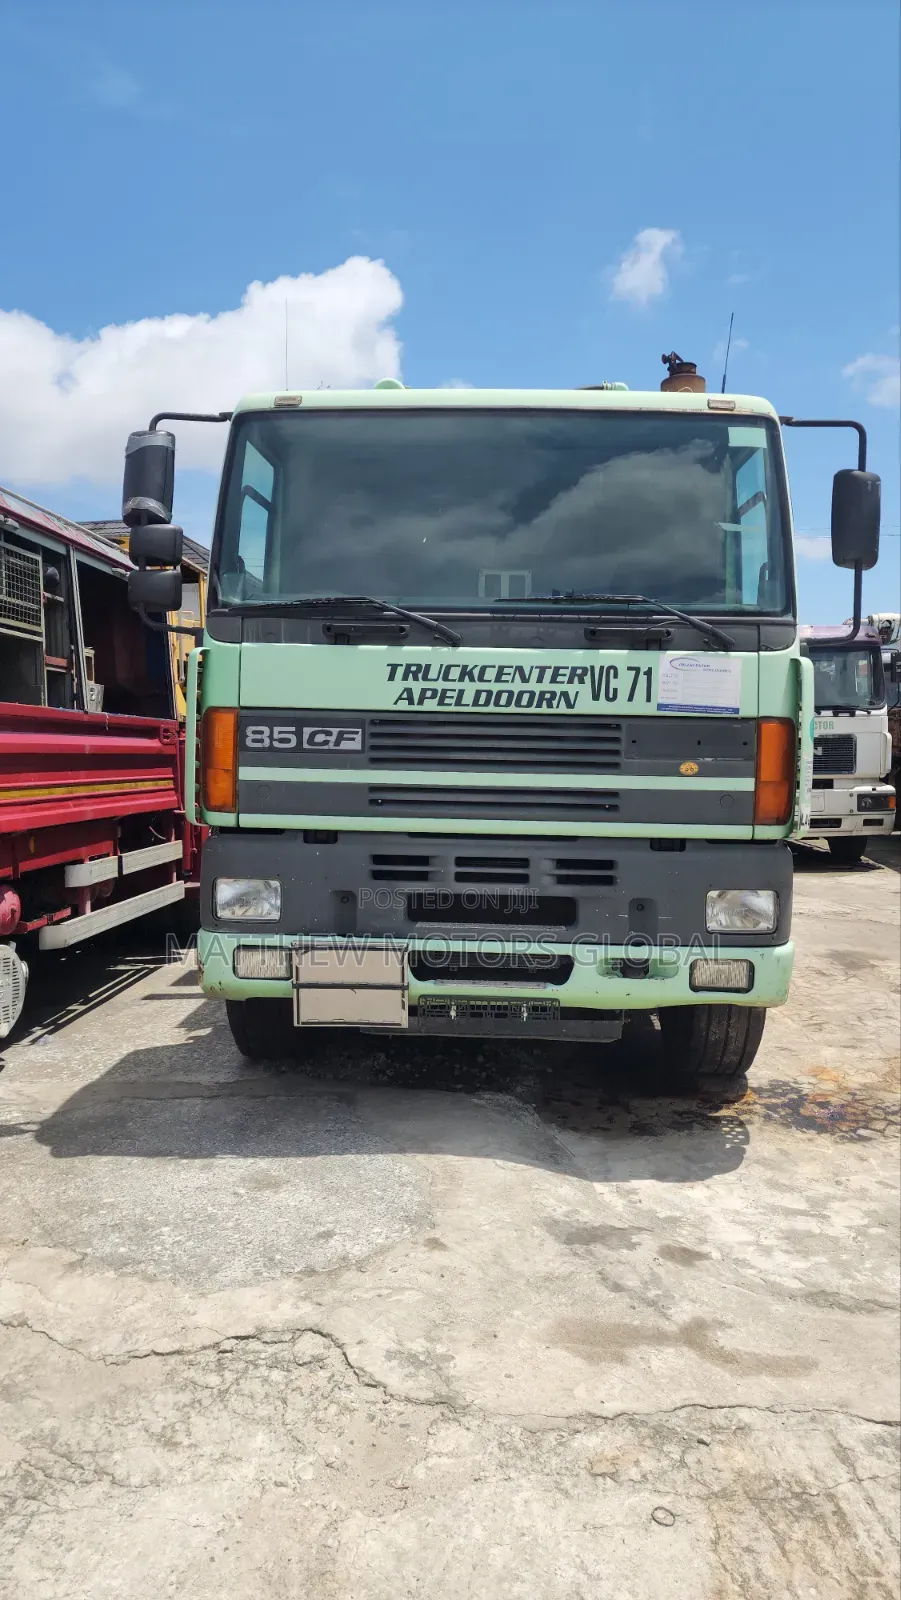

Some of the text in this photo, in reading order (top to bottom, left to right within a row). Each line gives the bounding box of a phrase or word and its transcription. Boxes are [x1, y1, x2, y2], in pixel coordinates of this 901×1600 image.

[386, 663, 589, 684] TRUCKCENTER
[590, 665, 653, 703] VC 71
[393, 687, 579, 709] APELDOORN
[245, 725, 360, 749] 85 CF
